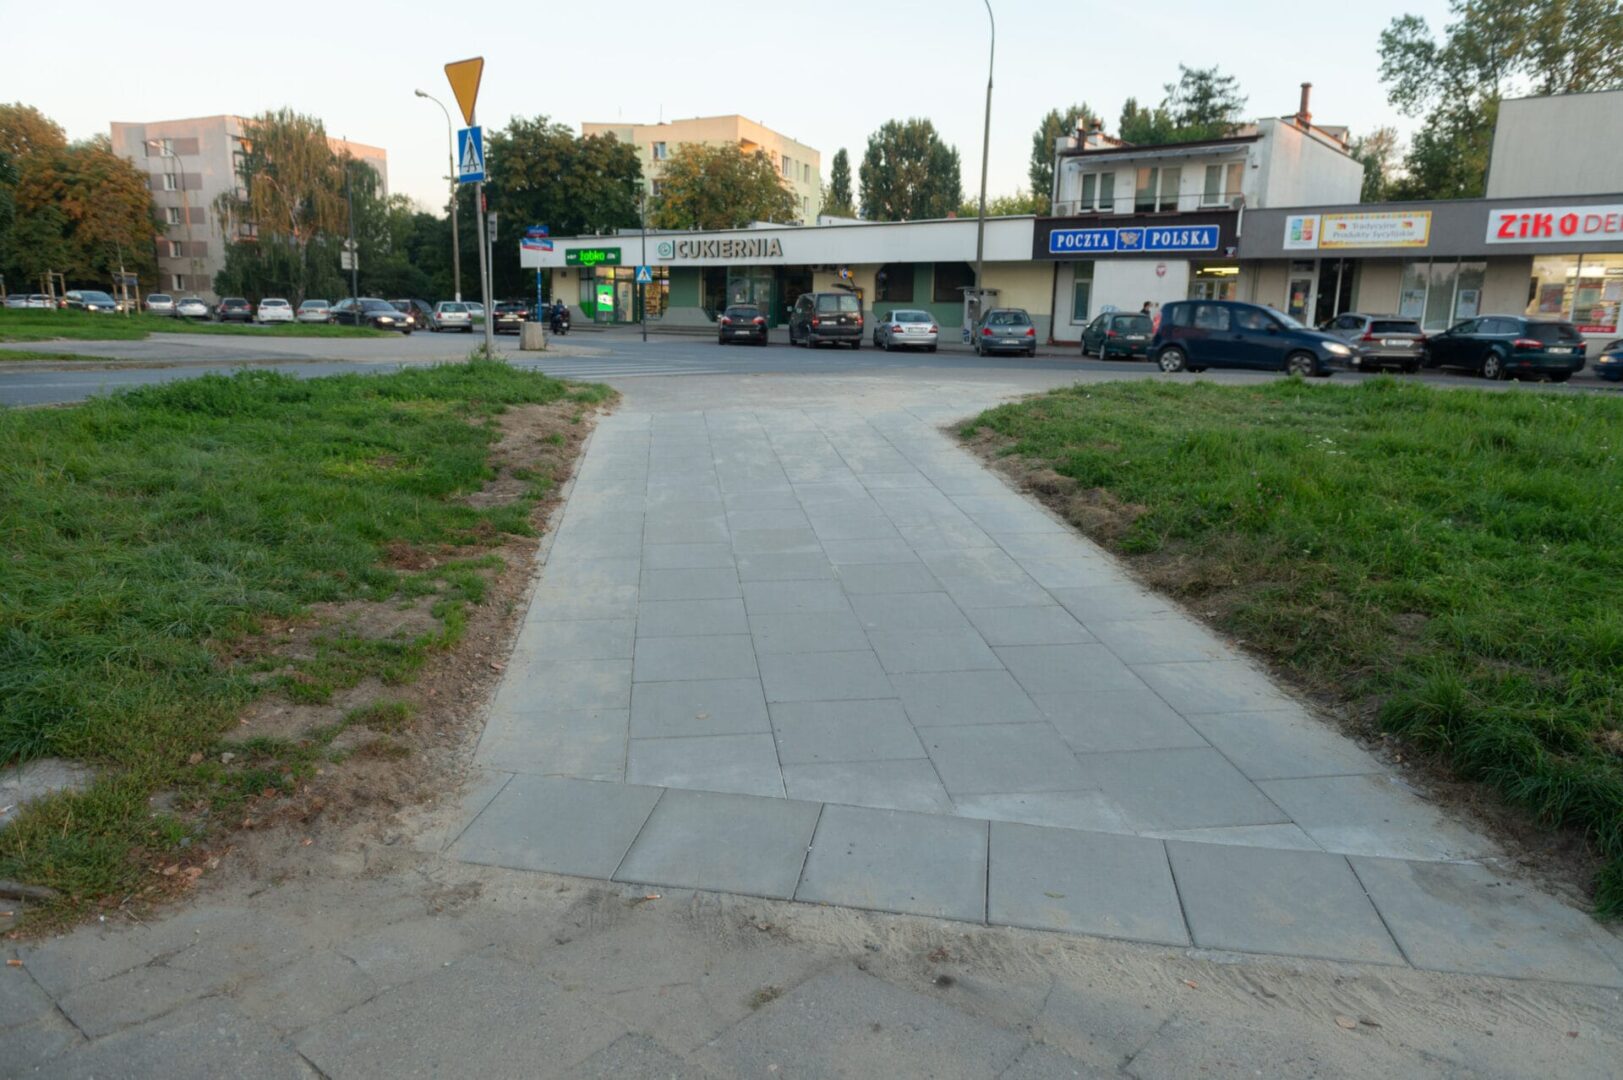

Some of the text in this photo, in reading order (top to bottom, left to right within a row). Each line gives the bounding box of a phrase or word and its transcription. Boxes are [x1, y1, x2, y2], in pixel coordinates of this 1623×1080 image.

[1583, 213, 1623, 234] DE
[677, 238, 784, 260] CUKIERNIA
[1056, 230, 1210, 248] POCZTA POLSKA
